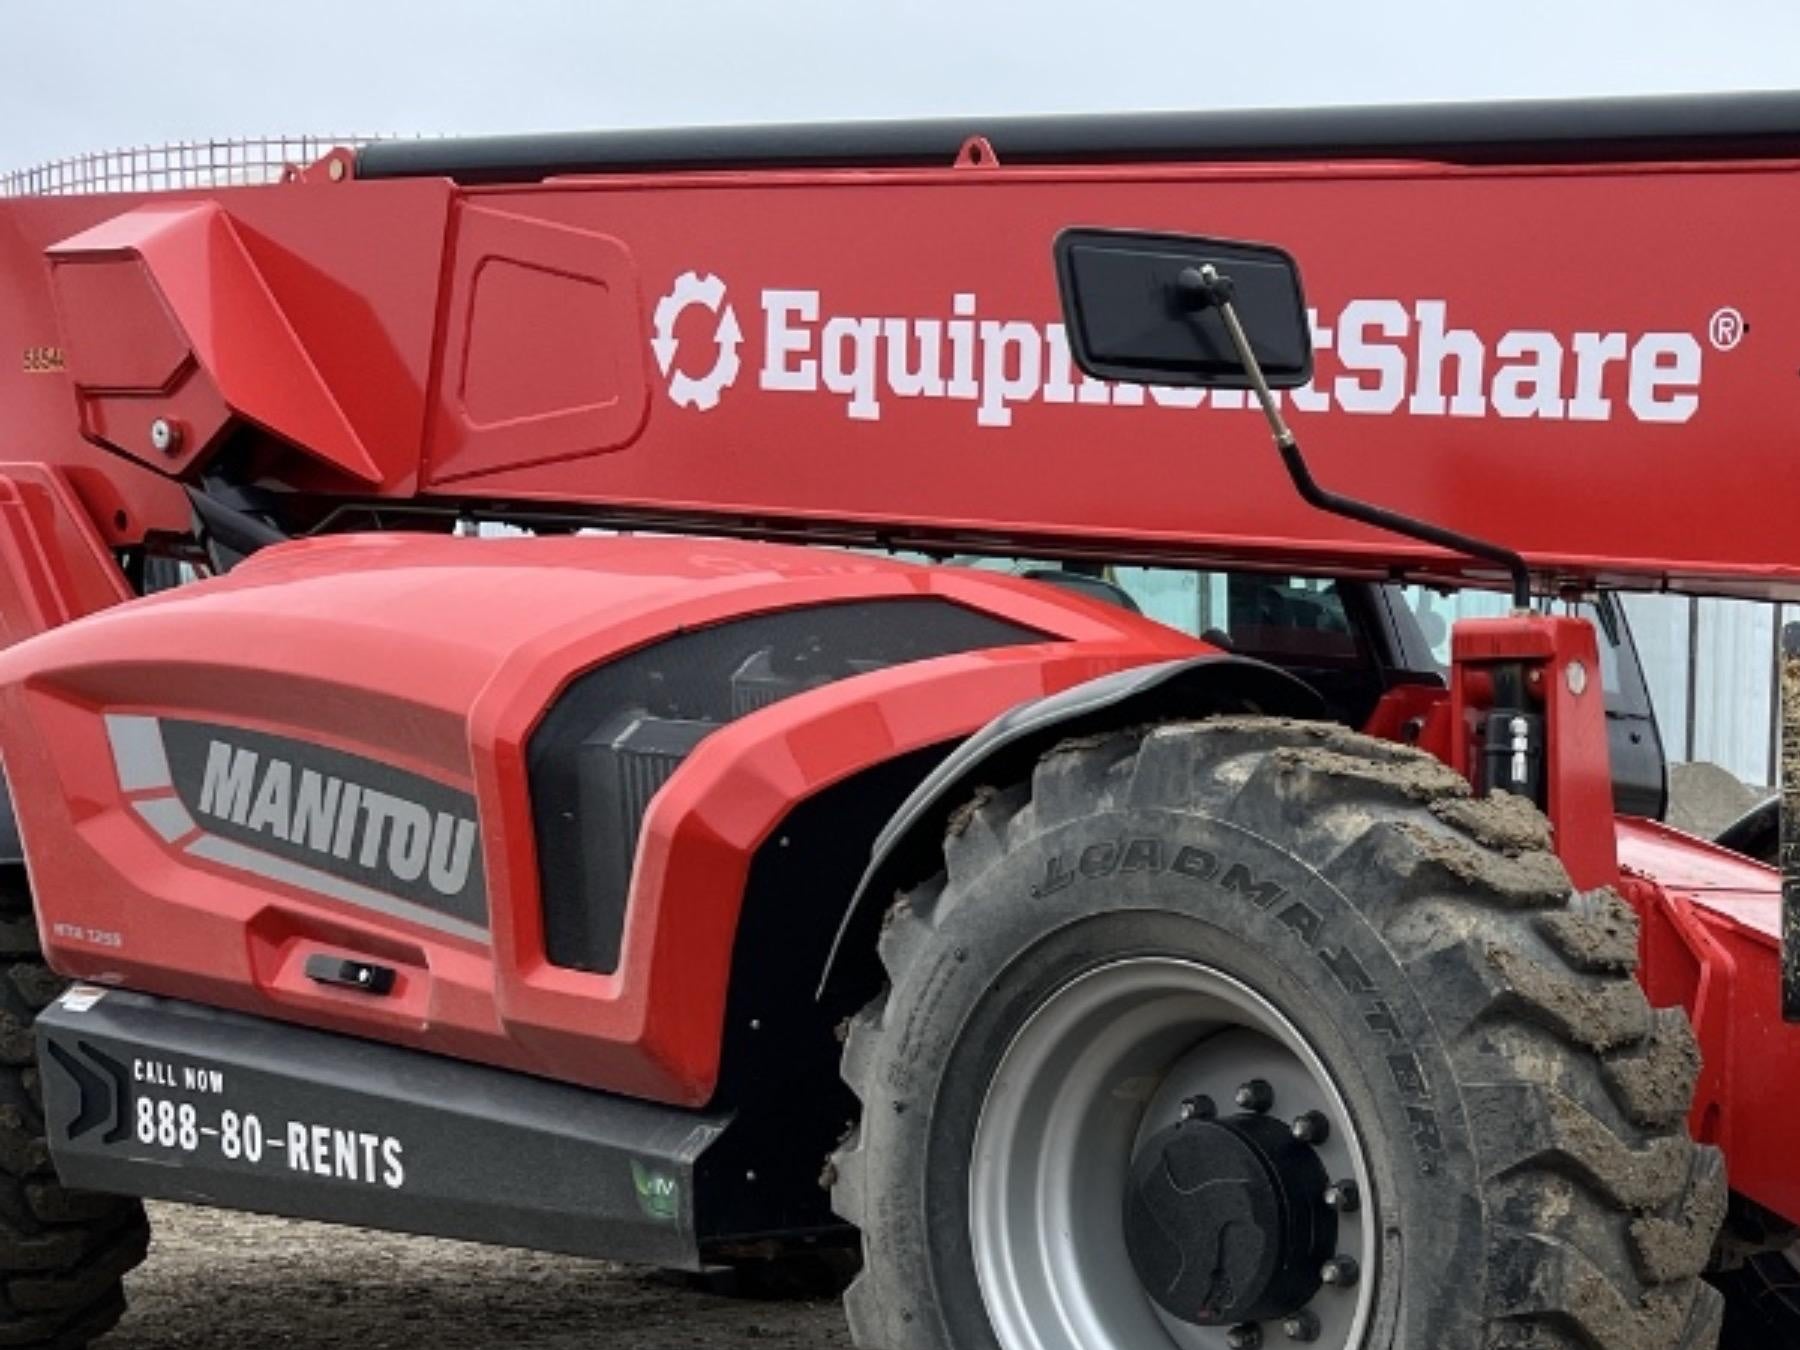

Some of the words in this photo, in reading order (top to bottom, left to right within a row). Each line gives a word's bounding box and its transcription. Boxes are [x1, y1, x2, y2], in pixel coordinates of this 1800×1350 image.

[199, 740, 477, 895] MANITOU
[134, 1058, 178, 1088] CALL
[183, 1067, 223, 1094] NOW
[136, 1096, 404, 1189] 888-80-RENTS
